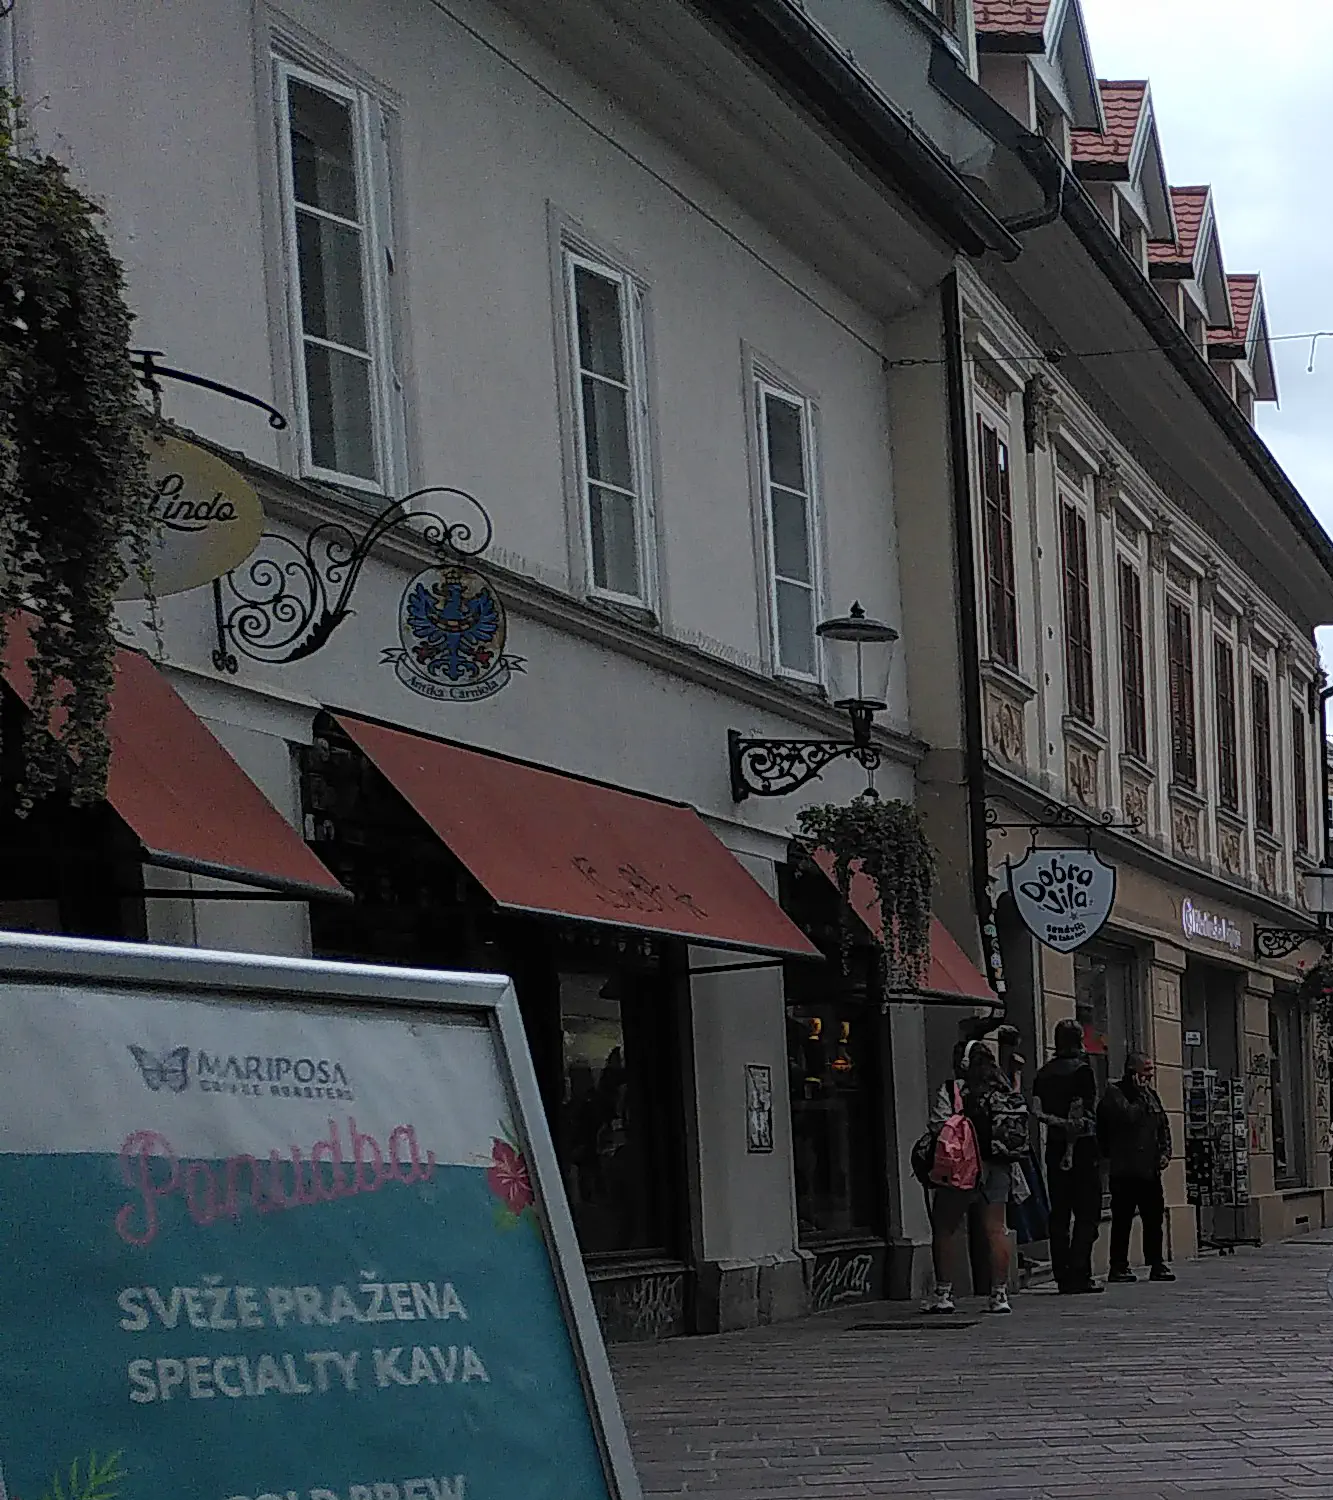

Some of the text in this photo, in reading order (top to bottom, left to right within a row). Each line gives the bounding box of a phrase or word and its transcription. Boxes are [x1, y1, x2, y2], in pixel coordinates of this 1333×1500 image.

[1019, 857, 1095, 904] Dobra
[1042, 881, 1091, 914] Vila
[197, 1051, 348, 1085] MARIPOSA
[115, 1115, 437, 1247] Ponudba
[117, 1271, 469, 1332] SVEŽE PRAŽENA
[127, 1345, 491, 1404] SPECIALTY KAVA
